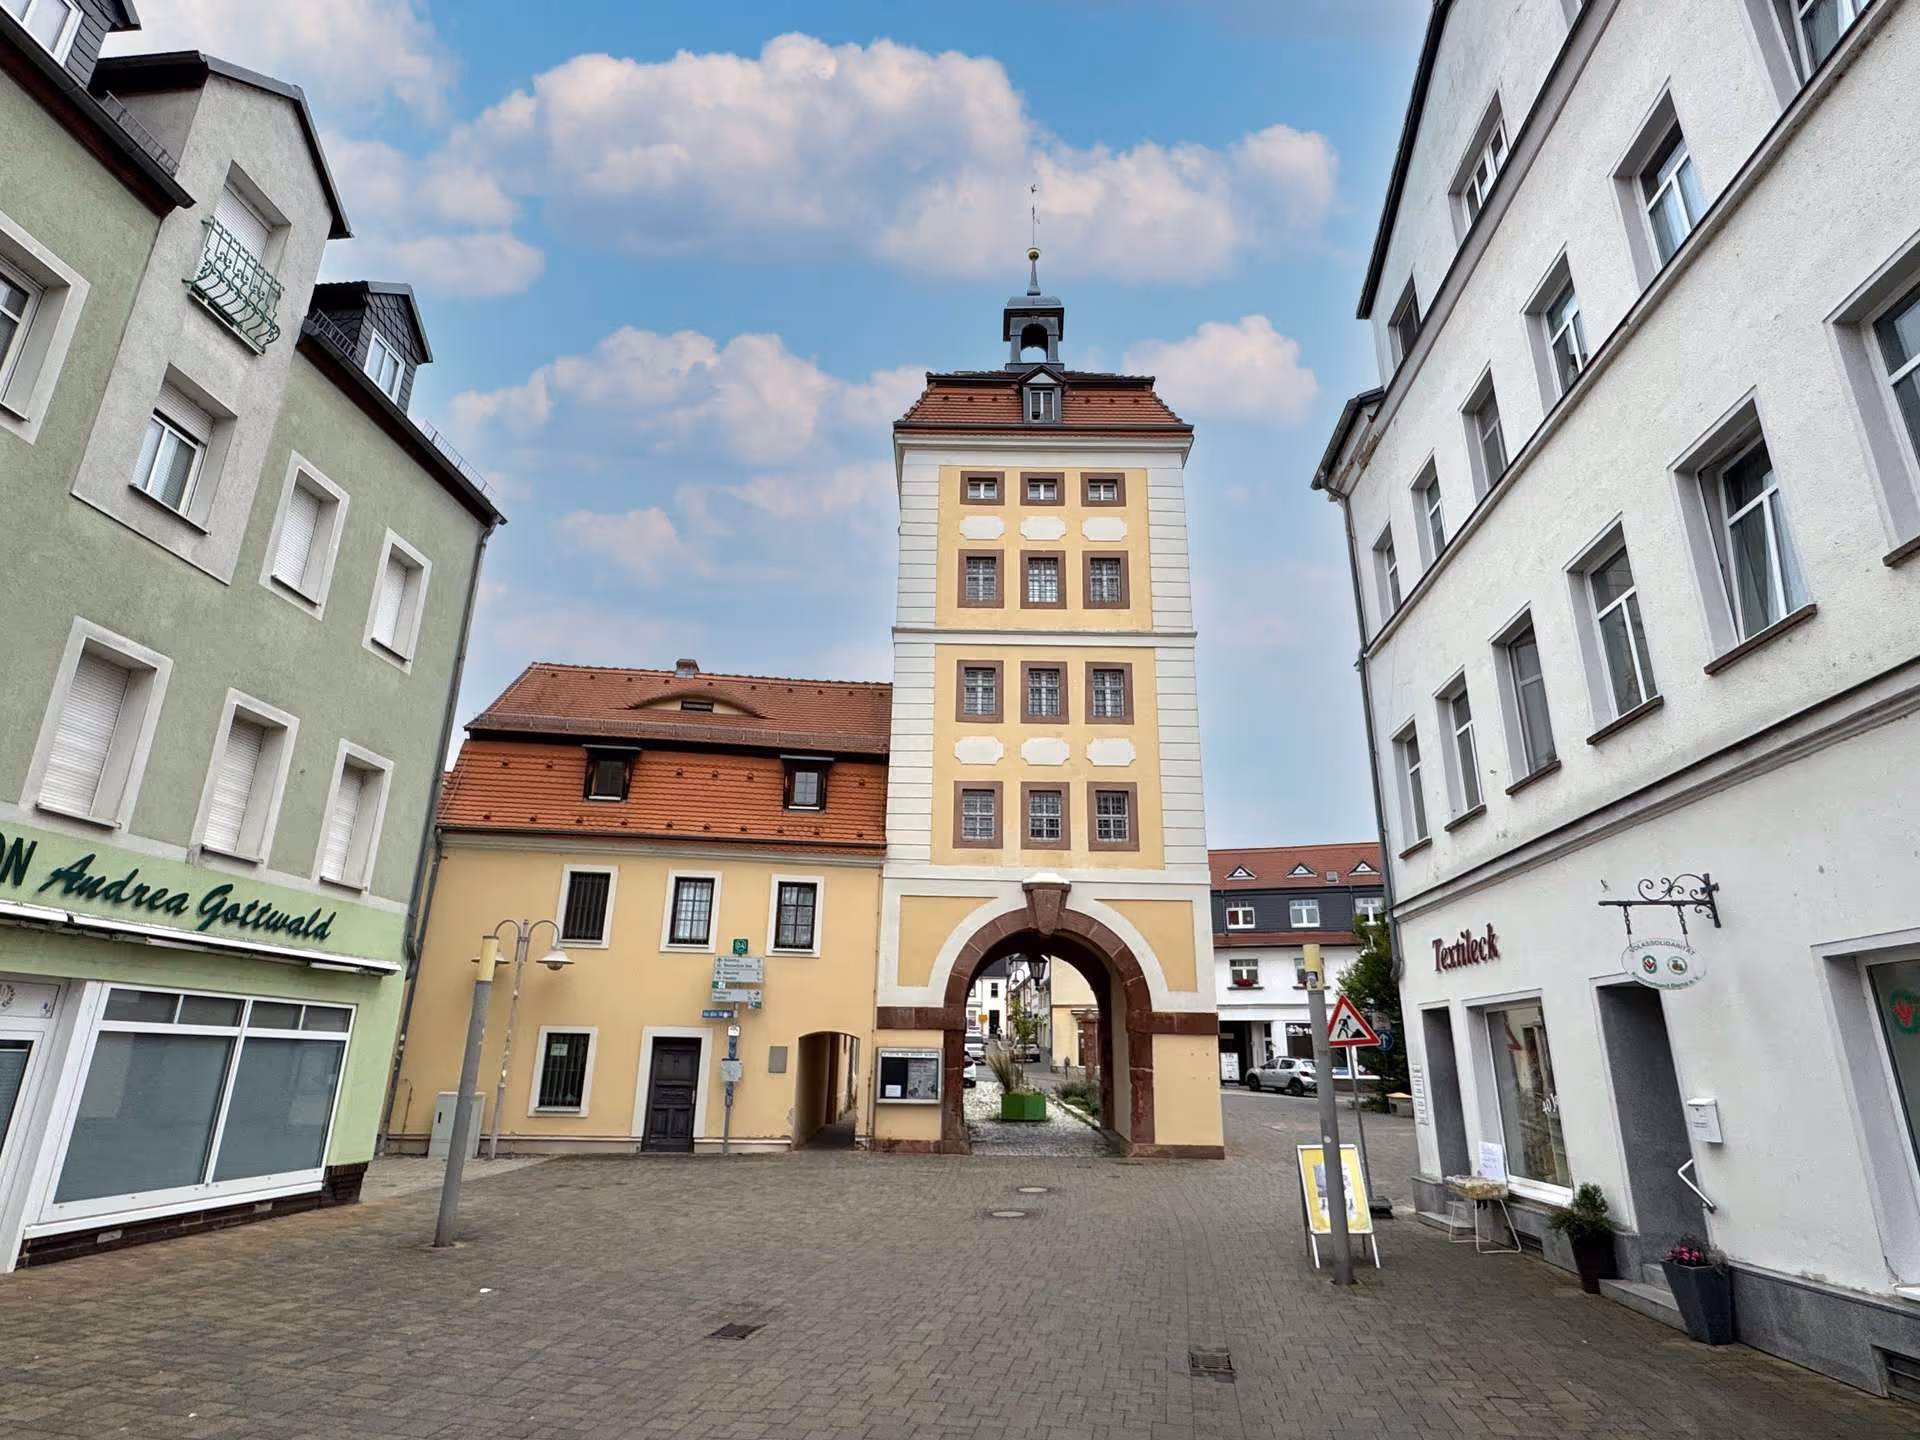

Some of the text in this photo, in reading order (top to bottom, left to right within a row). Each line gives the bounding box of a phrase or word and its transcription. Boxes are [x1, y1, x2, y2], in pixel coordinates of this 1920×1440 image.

[38, 853, 189, 915] Andrea
[196, 883, 336, 940] Gottwald
[1432, 922, 1499, 972] Textileck
